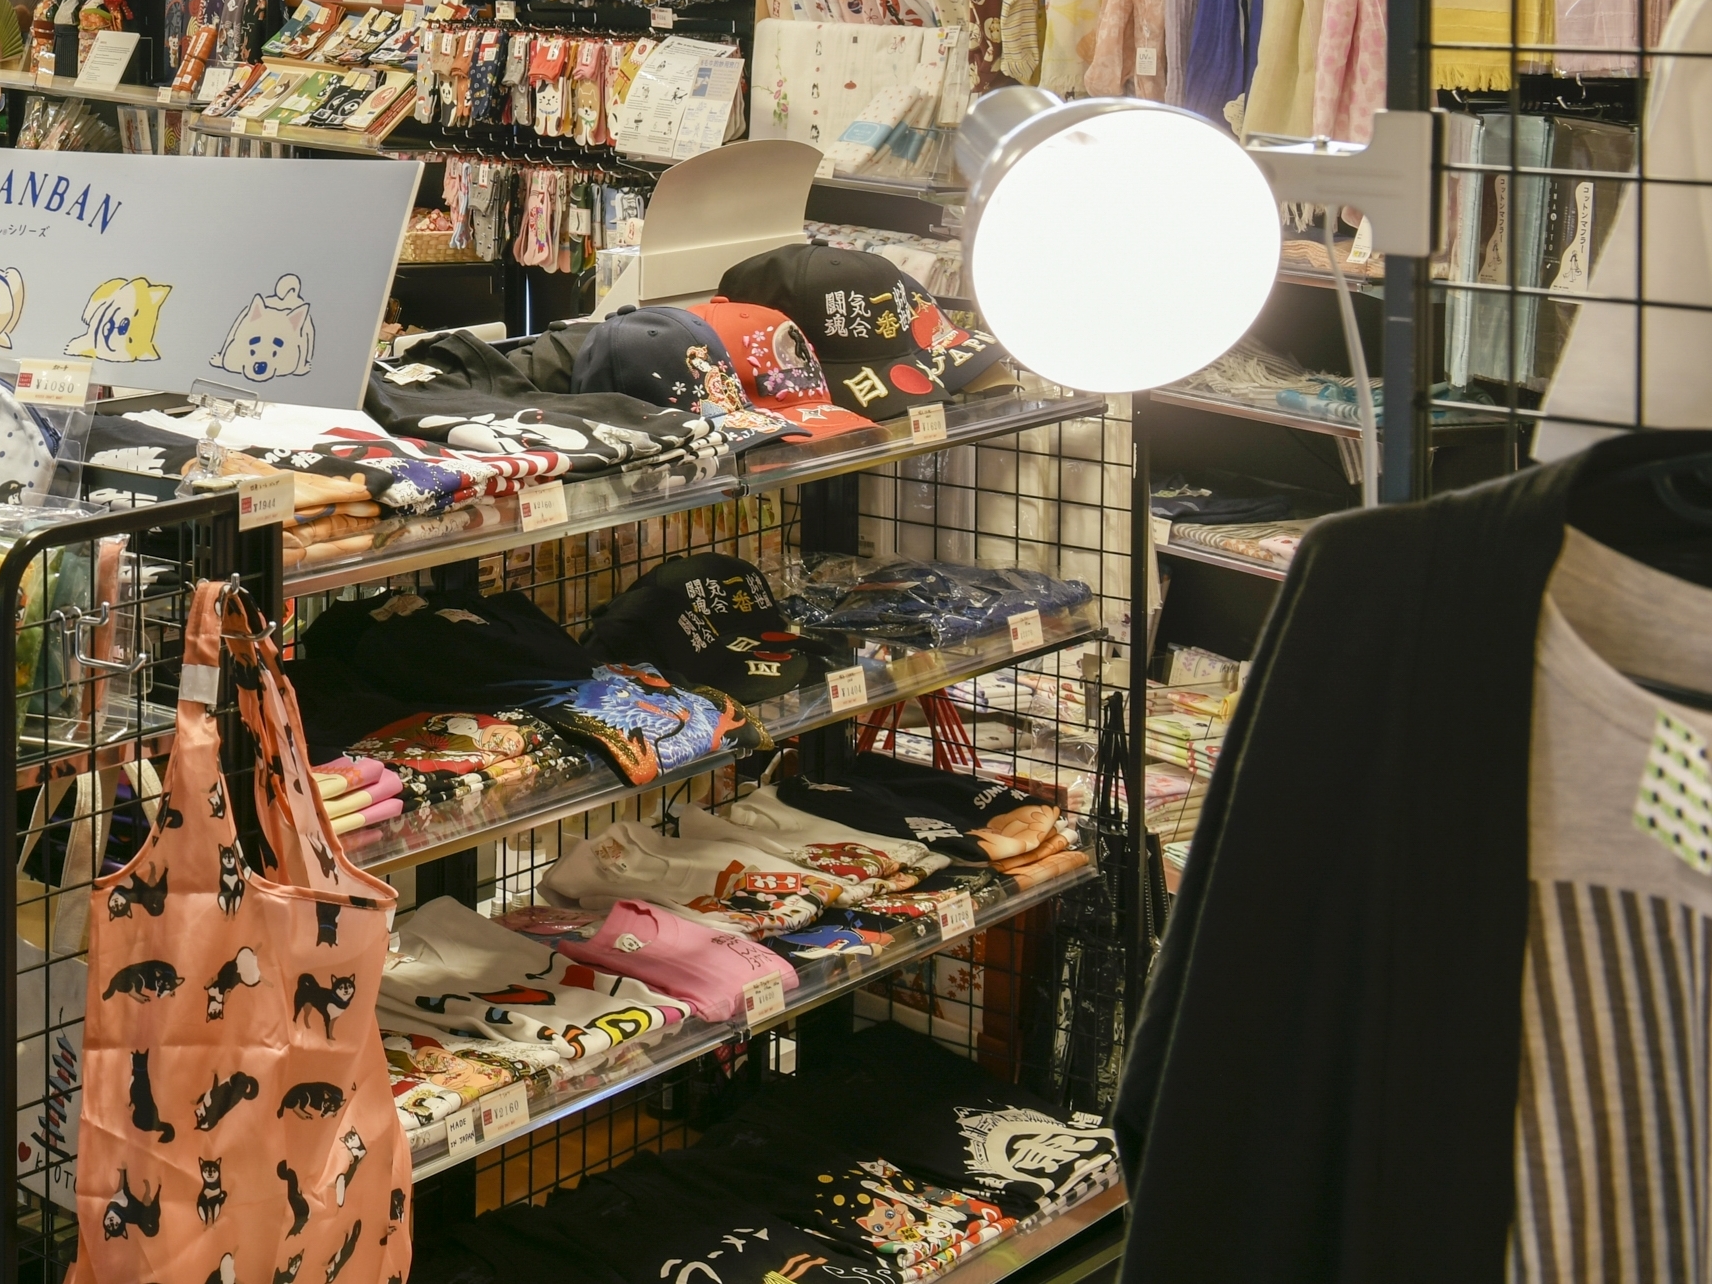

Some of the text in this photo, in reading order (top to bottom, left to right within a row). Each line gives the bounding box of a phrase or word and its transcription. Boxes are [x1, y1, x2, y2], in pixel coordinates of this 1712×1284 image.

[1579, 187, 1590, 254] コットンマフラー
[848, 290, 872, 338] 気合
[869, 292, 900, 339] 一番
[36, 378, 75, 394] ¥1080
[722, 576, 754, 612] 一番
[841, 685, 862, 698] ¥1404
[494, 1100, 519, 1120] ¥2160
[450, 1117, 467, 1132] MADE
[450, 1130, 475, 1148] IN JAPAN
